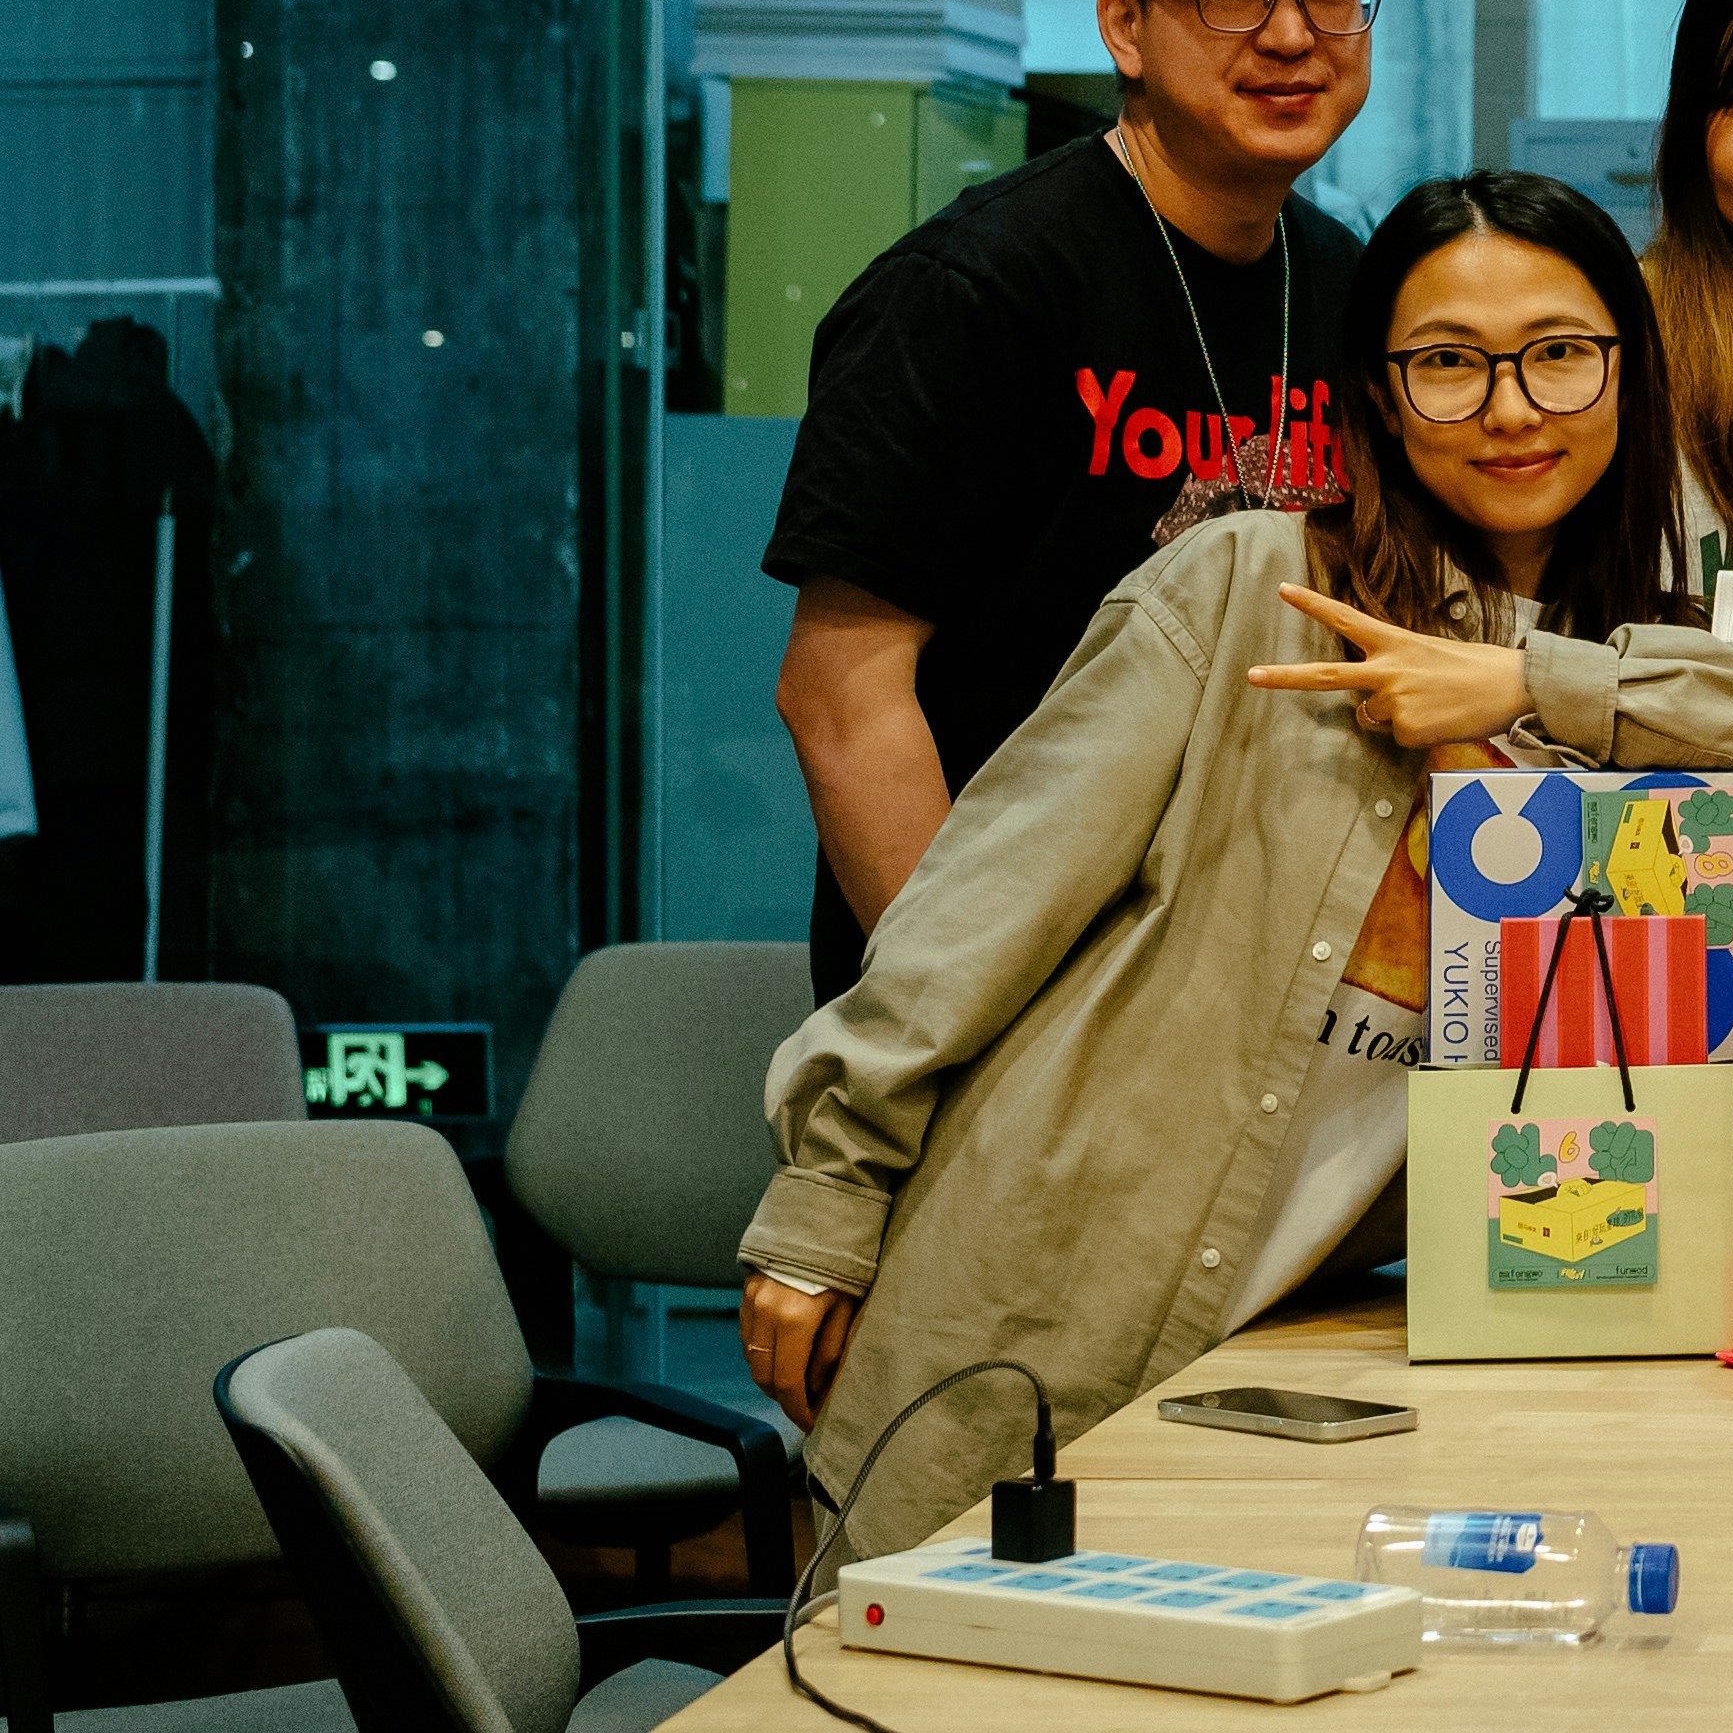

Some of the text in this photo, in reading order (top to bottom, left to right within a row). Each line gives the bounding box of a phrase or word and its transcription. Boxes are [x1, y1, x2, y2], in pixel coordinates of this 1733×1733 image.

[1075, 367, 1256, 485] Your
[1443, 941, 1469, 1044] YUKIO
[1480, 940, 1501, 1062] Supervised
[1559, 1131, 1580, 1163] 6
